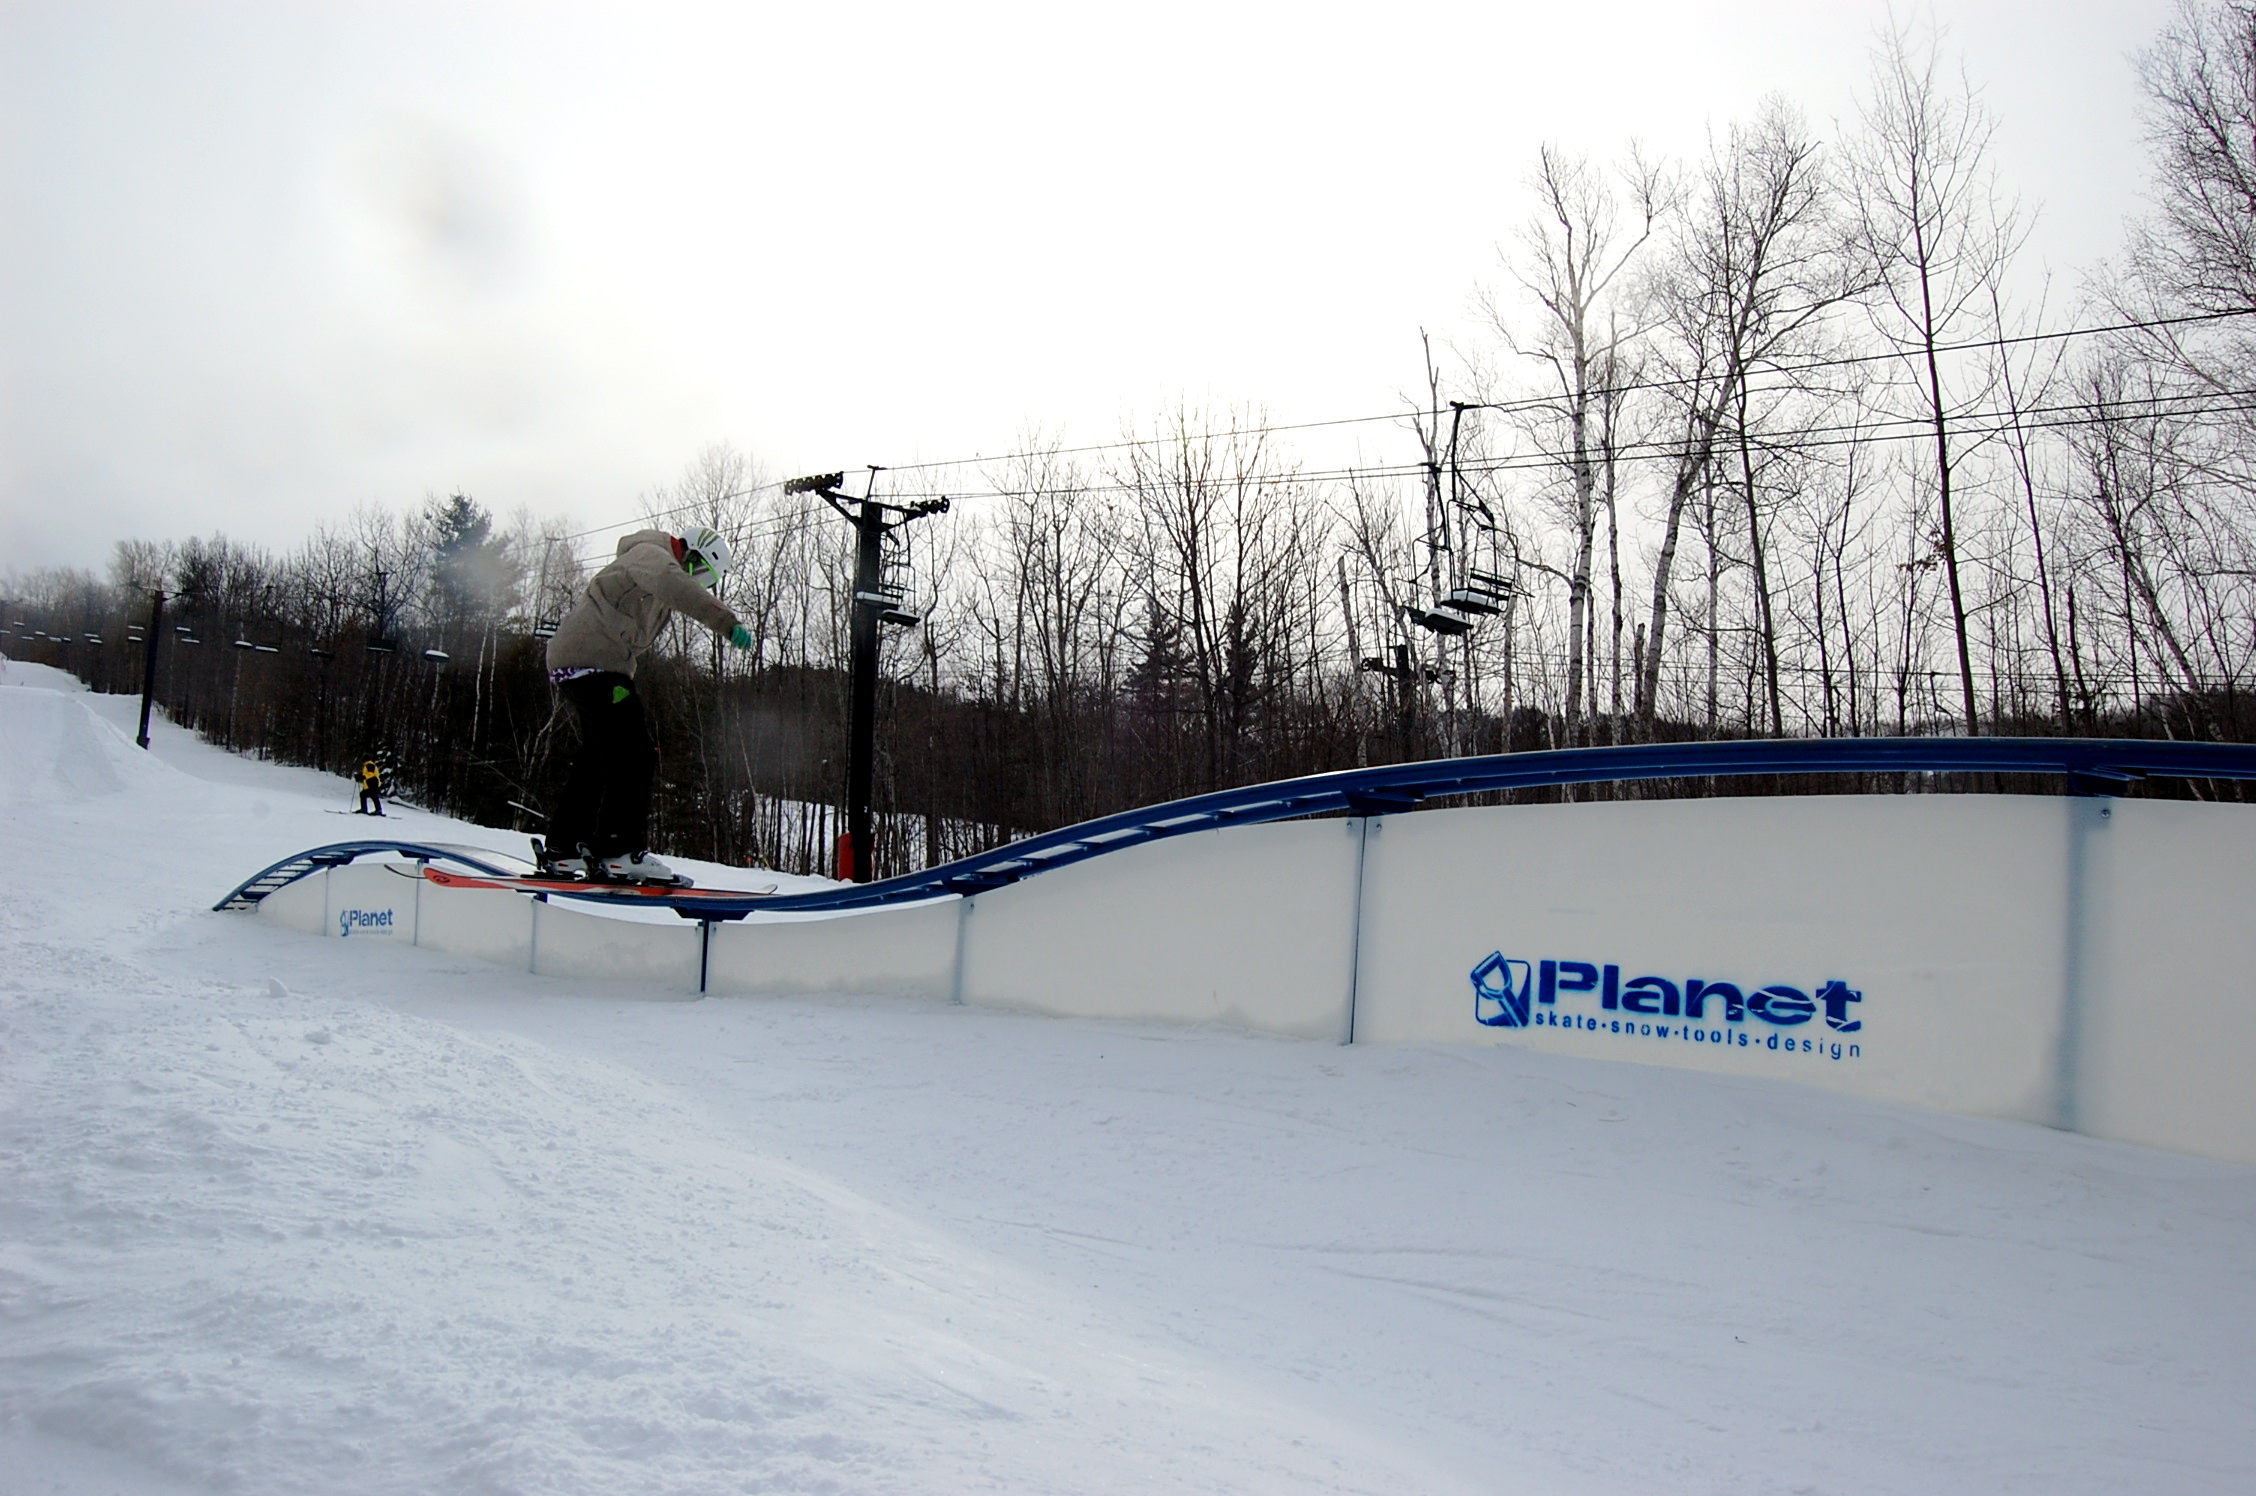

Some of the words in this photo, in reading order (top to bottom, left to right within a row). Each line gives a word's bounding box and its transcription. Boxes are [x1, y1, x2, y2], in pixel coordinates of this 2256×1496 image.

[349, 908, 393, 927] Planet
[1538, 959, 1863, 1034] Planet
[1535, 1009, 1597, 1032] skate
[1610, 1020, 1670, 1039] snow
[1682, 1025, 1749, 1047] tools
[1766, 1032, 1861, 1061] design
